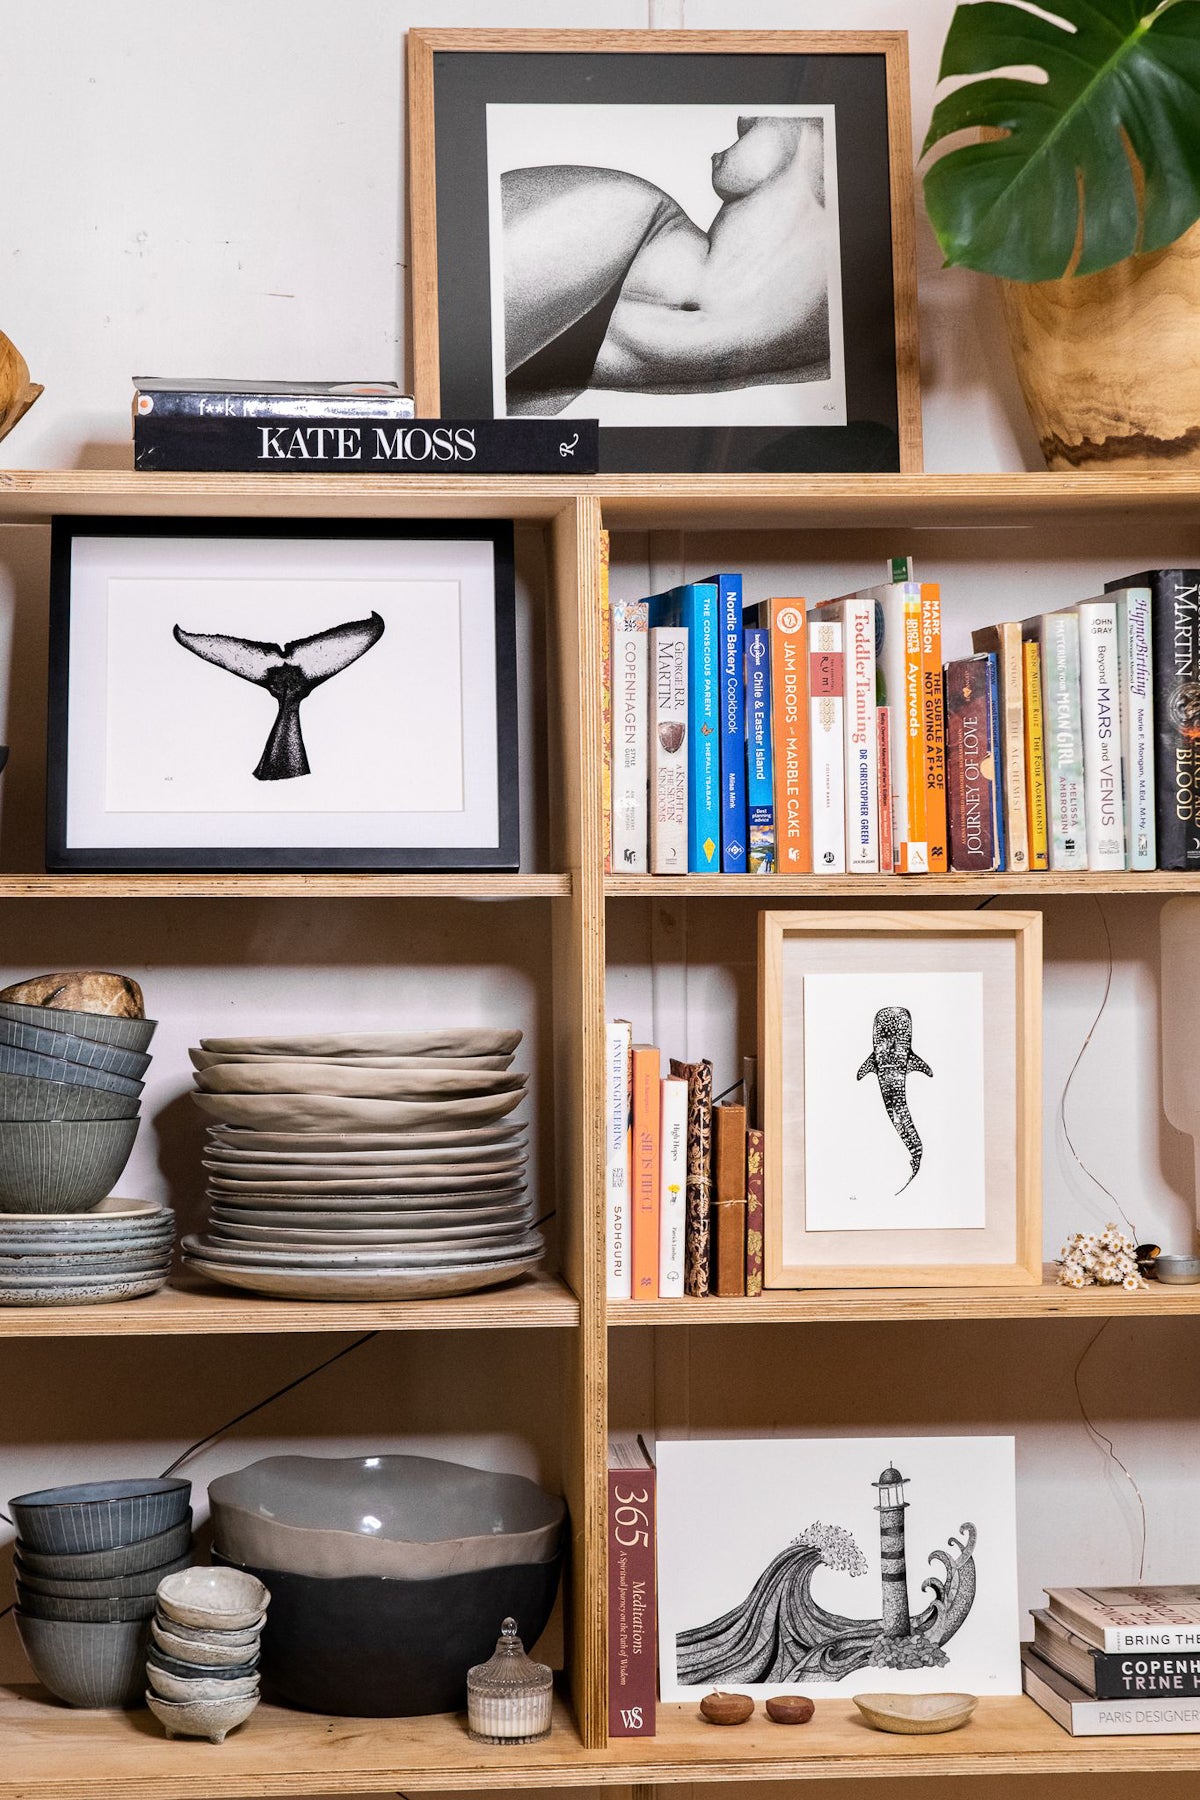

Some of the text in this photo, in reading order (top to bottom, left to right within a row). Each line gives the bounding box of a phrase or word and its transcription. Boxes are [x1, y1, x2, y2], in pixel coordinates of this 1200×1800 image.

[257, 427, 478, 462] KATE MOSS
[922, 600, 933, 654] MANSON
[931, 600, 941, 635] MARK
[1090, 627, 1113, 635] GRAY
[1091, 618, 1113, 626] JOHN
[1174, 583, 1198, 676] MARTIN
[703, 598, 712, 718] THE CONSCIOUS PARENT
[725, 591, 739, 735] Nordic Bakery Cookbook
[784, 641, 797, 671] JAM
[1096, 645, 1108, 685] Beyond
[1129, 599, 1151, 698] HypnoBirthing
[624, 641, 638, 745] COPENHAGEN
[658, 641, 674, 711] MARTIN
[674, 641, 686, 711] GEORGE R.R.
[924, 671, 934, 697] NOT
[1031, 671, 1039, 705] MIGUEL
[785, 674, 798, 724] DROPS
[907, 662, 921, 738] Ayurveda
[1033, 708, 1041, 728] RUIZ
[1056, 692, 1073, 730] MEAN
[1097, 687, 1112, 739] MARS
[753, 671, 766, 780] Chile & Easter Island
[924, 699, 935, 742] GIVING
[933, 671, 945, 790] THE SUBTLE ART OF
[963, 716, 979, 755] LOVE
[624, 748, 632, 769] GUIDE
[926, 745, 935, 754] A
[1033, 736, 1041, 752] THE
[1056, 731, 1075, 770] GIRL
[1100, 742, 1110, 762] and
[1136, 742, 1146, 778] Mongan,
[785, 737, 799, 796] MARBLE
[964, 758, 980, 780] OF
[1034, 755, 1043, 777] FOUR
[1175, 748, 1193, 821] BLOOD
[658, 767, 668, 823] KINGDOMS
[667, 787, 676, 822] SEVEN
[675, 771, 685, 813] KNIGHT
[729, 792, 737, 809] Mink
[859, 748, 870, 845] DR CHRISTOPHER GREEN
[1035, 781, 1044, 835] AGREEMENTS
[1059, 776, 1069, 835] AMBROSINI
[1069, 783, 1079, 827] MELISSA
[1099, 764, 1115, 826] VENUS
[787, 798, 801, 838] CAKE
[965, 784, 984, 856] JOURNEY
[613, 1039, 622, 1150] INNER ENGINEERING
[669, 1123, 681, 1162] High Hopes
[613, 1206, 623, 1278] SADHGURU
[614, 1485, 649, 1548] 365
[617, 1556, 628, 1587] Spiritual
[617, 1587, 628, 1613] Journey
[619, 1613, 626, 1622] on
[632, 1580, 647, 1655] Meditations
[619, 1622, 628, 1633] the
[619, 1634, 628, 1649] Path
[1124, 1634, 1170, 1646] BRING
[618, 1649, 628, 1658] of
[619, 1658, 629, 1686] Wisdom
[1122, 1675, 1184, 1691] TRINE
[1098, 1711, 1132, 1725] PARIS
